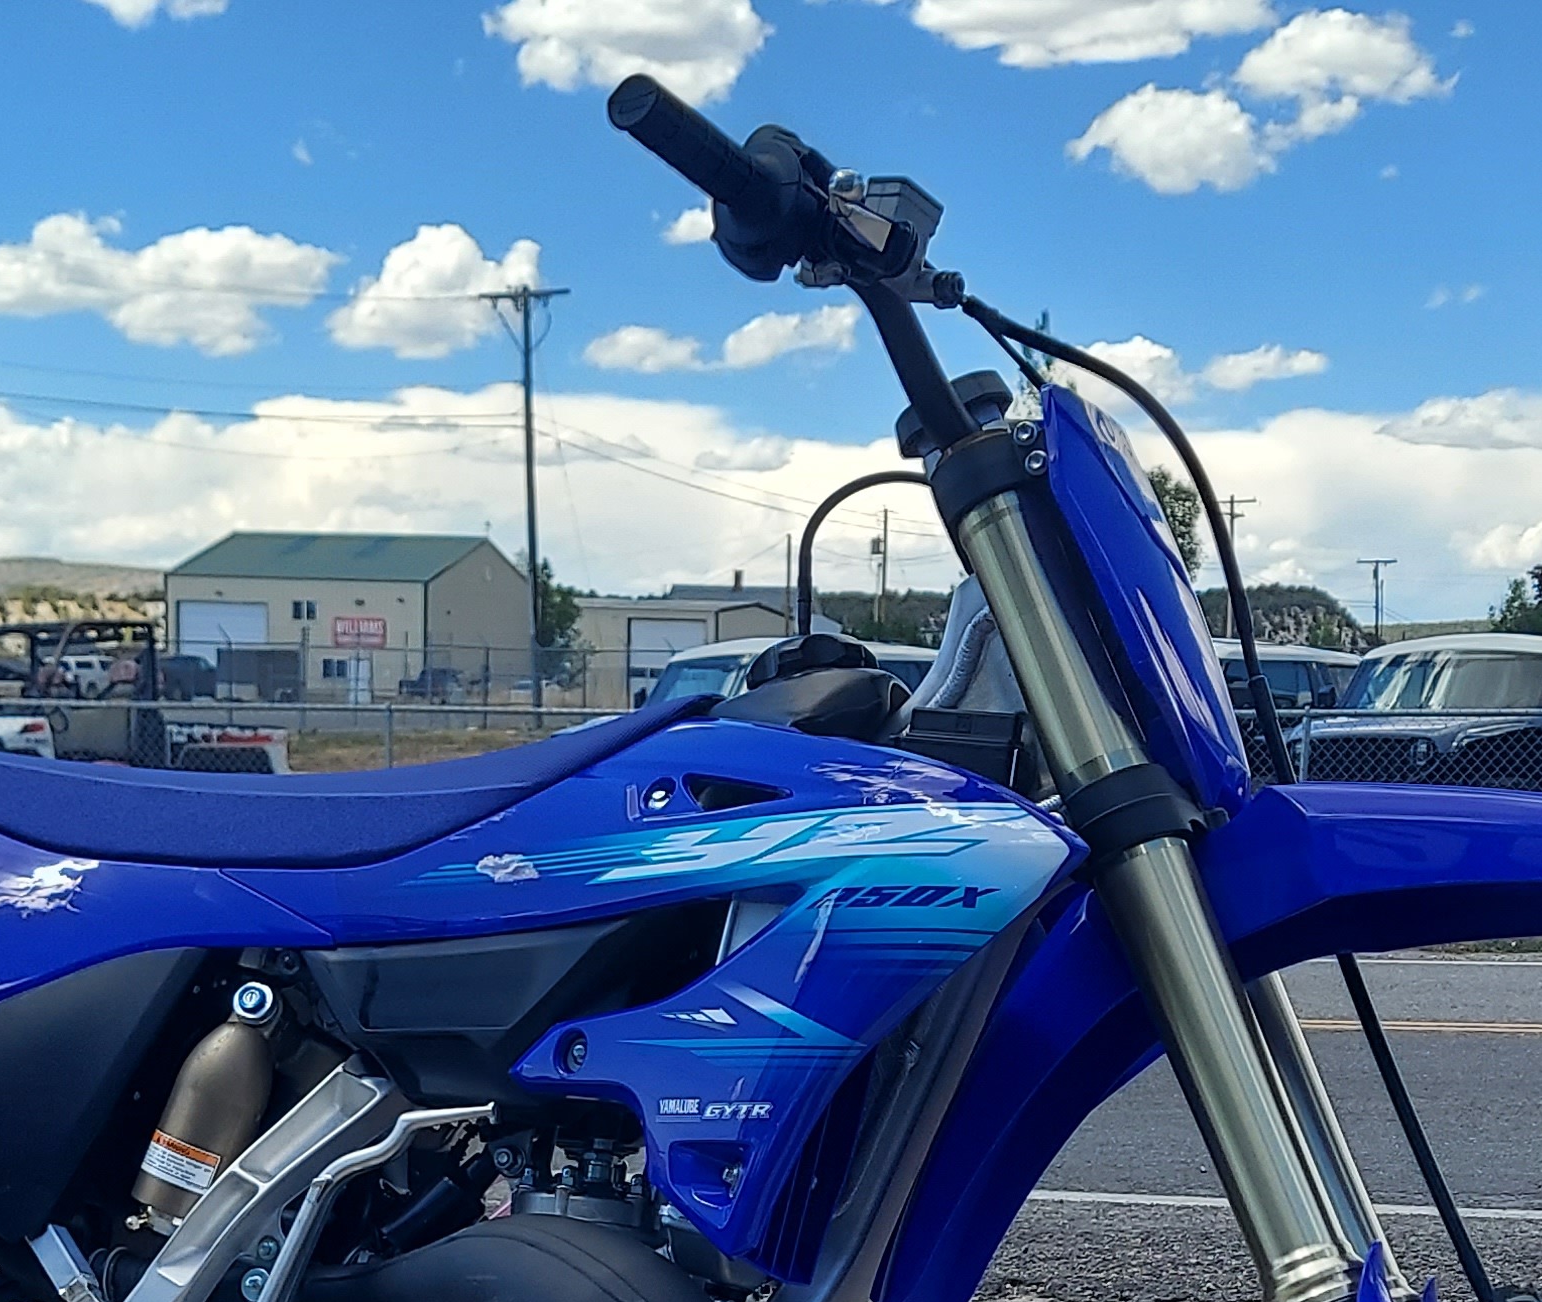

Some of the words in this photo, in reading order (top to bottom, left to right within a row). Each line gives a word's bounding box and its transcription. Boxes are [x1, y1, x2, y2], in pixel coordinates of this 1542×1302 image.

[806, 885, 1002, 910] 250X
[659, 1099, 700, 1115] YAMALUBE
[701, 1102, 774, 1120] GYTR
